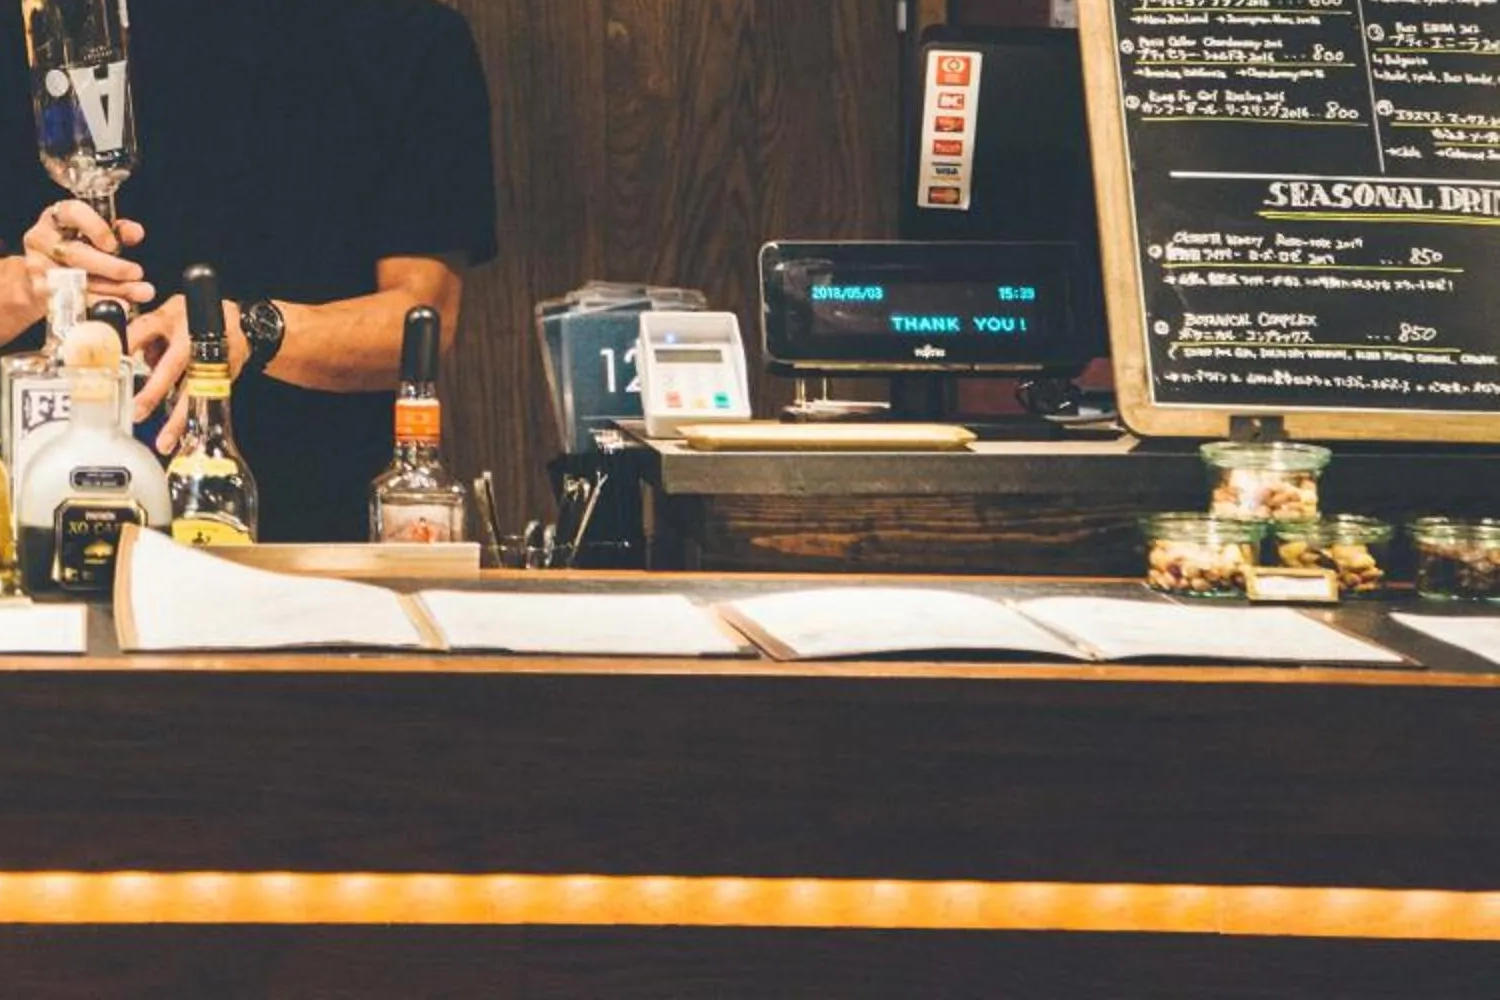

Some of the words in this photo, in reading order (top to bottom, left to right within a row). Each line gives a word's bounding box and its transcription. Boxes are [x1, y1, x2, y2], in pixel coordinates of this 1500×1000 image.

[1311, 43, 1344, 62] 800
[1324, 100, 1361, 120] 800
[1262, 180, 1433, 211] SEASONAL
[1409, 247, 1444, 266] 850
[890, 316, 961, 332] THANK
[1183, 312, 1253, 328] BOTANICAL
[1257, 311, 1318, 329] COMPLEX
[1397, 321, 1438, 343] 850
